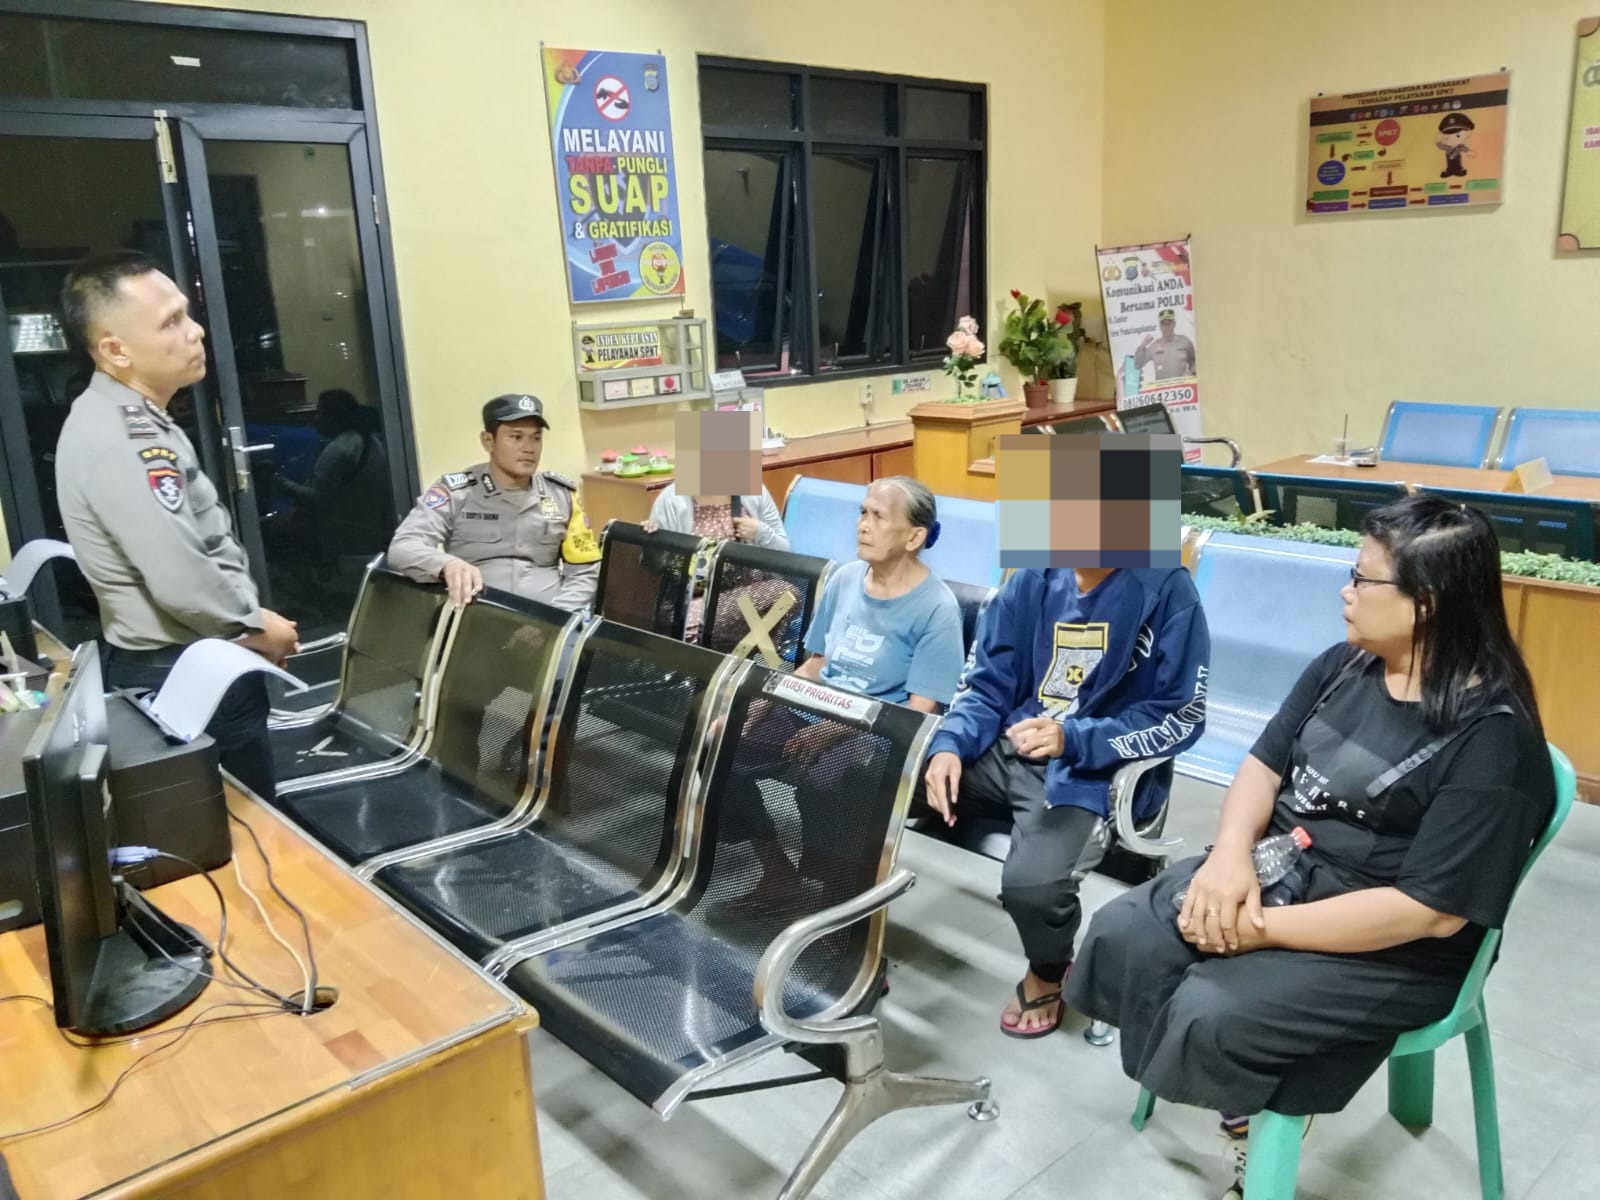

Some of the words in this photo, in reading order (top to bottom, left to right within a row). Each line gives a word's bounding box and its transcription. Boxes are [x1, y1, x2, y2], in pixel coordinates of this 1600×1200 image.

[563, 128, 665, 154] MELAYANI
[617, 157, 667, 174] PUNGLI
[569, 174, 669, 214] SUAP
[575, 222, 585, 239] &
[588, 220, 672, 239] GRATIFIKASI
[1105, 281, 1155, 298] Komunikasi
[1157, 278, 1184, 292] ANDA
[1120, 300, 1155, 314] Bersama
[1157, 294, 1185, 308] POLRI
[597, 346, 639, 361] PELAYANAN
[640, 345, 658, 358] SPKT
[804, 686, 853, 710] PRIORITAS
